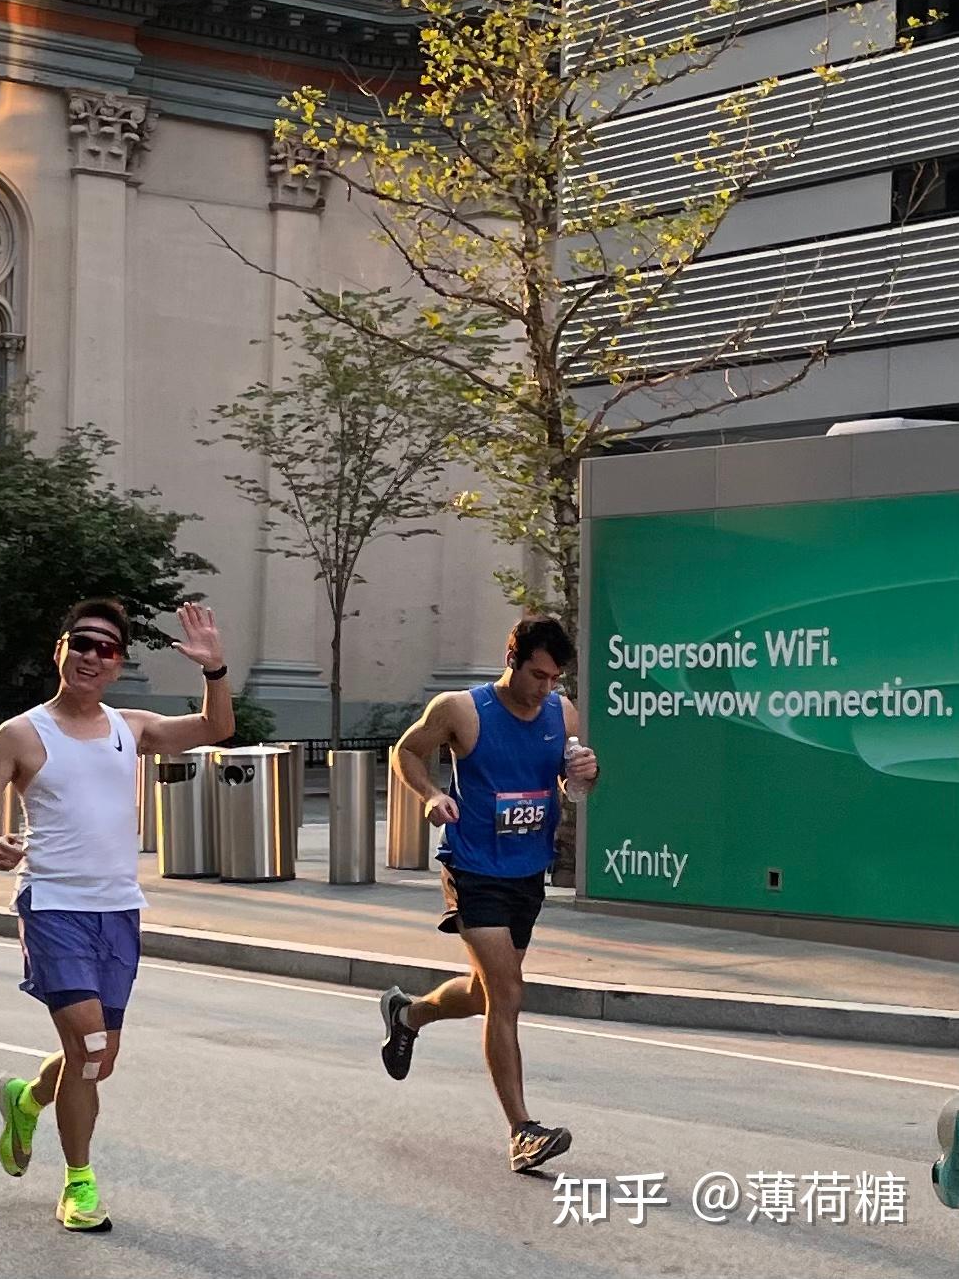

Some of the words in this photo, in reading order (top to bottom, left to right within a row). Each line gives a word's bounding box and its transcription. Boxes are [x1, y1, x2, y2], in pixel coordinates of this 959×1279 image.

[608, 630, 758, 679] Supersonic
[765, 627, 838, 667] WiFi.
[607, 681, 761, 726] Super-wow
[768, 677, 953, 717] connection.
[502, 806, 545, 825] 1235
[604, 839, 688, 888] xfinity
